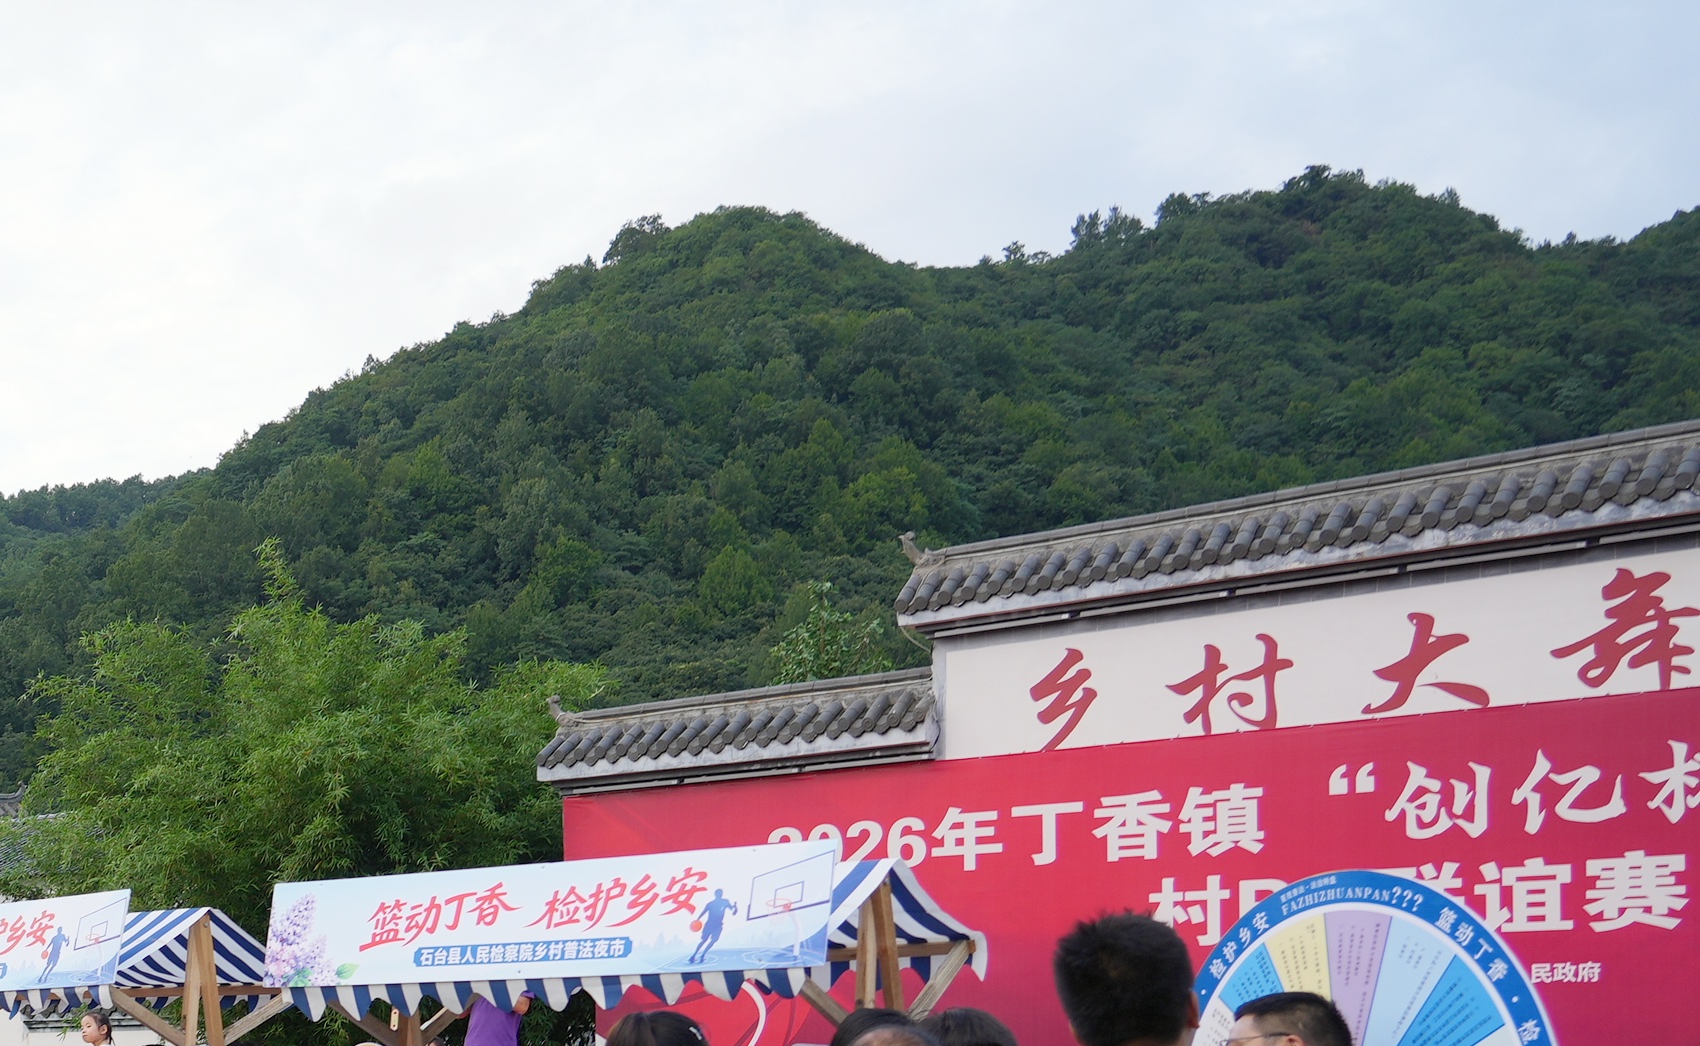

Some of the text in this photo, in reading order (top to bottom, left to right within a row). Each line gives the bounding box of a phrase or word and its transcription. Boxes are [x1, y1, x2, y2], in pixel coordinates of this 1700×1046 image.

[359, 867, 708, 952] 篮动丁香 检护乡安
[420, 938, 625, 966] 石台县人民检察院乡村普法夜市
[1209, 911, 1270, 980] 检护乡安
[1435, 906, 1508, 983] 篮动丁香
[1530, 962, 1601, 983] 民政府
